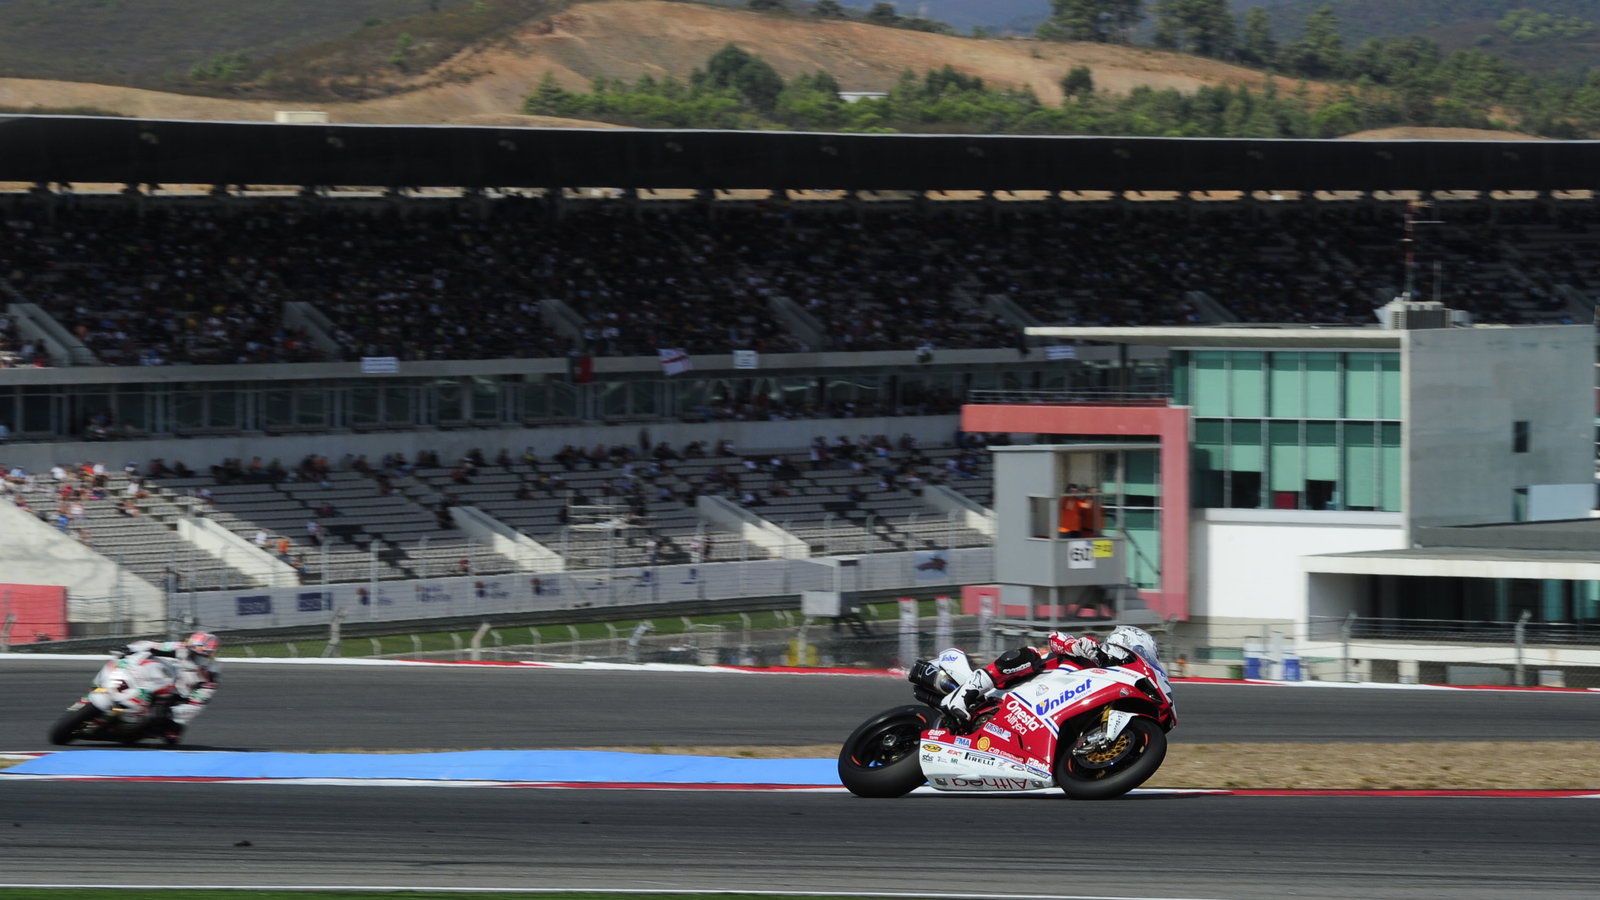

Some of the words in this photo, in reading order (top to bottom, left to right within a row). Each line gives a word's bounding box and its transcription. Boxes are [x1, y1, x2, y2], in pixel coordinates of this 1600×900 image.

[1036, 679, 1092, 716] Unibat
[1004, 713, 1028, 735] Althea
[964, 752, 995, 766] PIRELLI
[952, 778, 1028, 790] Althea
